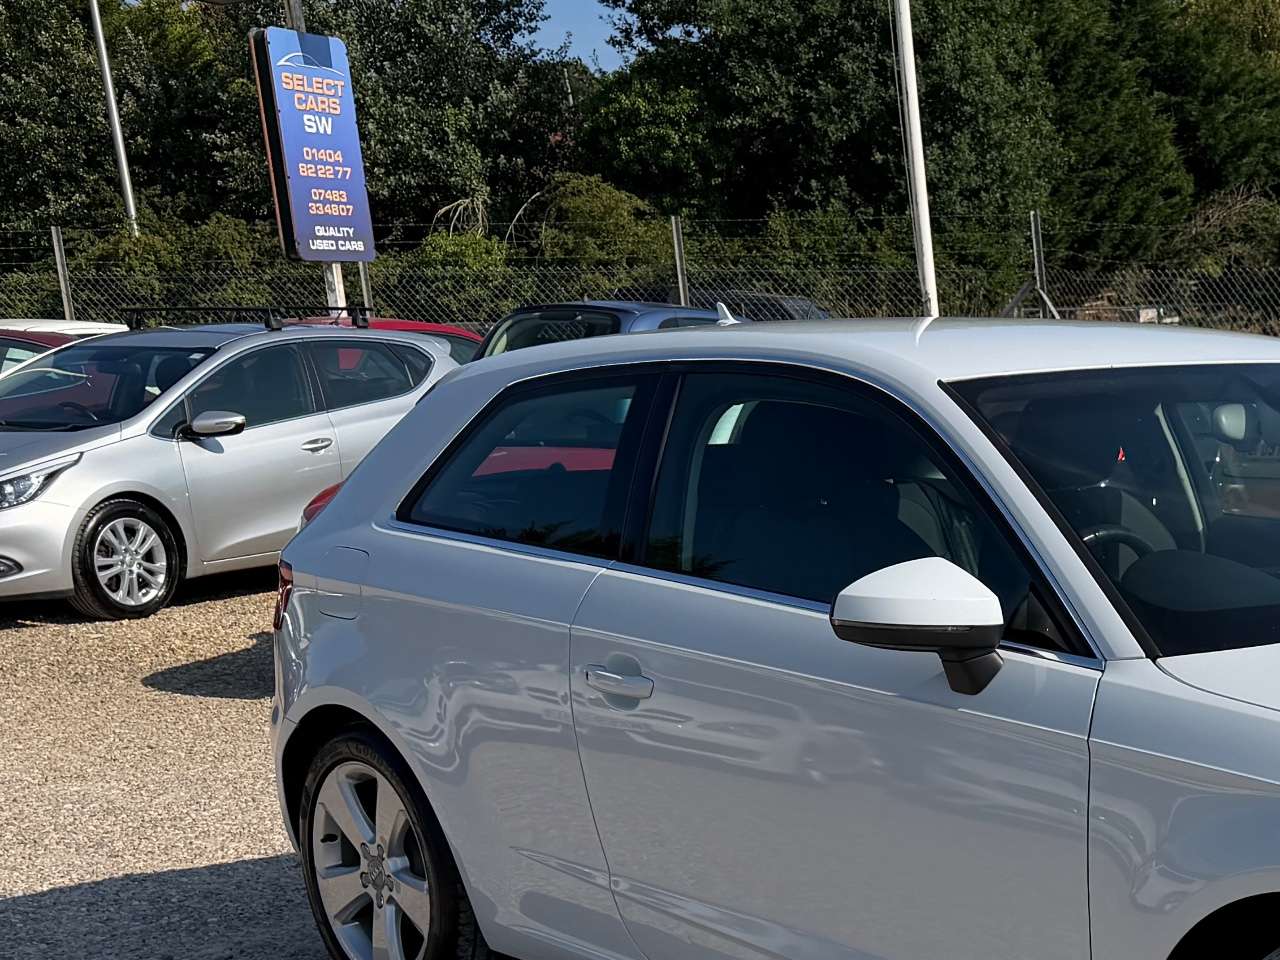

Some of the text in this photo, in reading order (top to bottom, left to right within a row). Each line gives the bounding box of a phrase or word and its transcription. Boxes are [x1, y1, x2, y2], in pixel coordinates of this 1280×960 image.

[281, 71, 345, 97] SELECT
[294, 93, 341, 115] CARS
[303, 114, 332, 135] SW
[303, 147, 342, 163] 01404
[311, 188, 348, 202] 07483
[308, 202, 353, 216] 334807
[314, 225, 354, 238] QUALITY
[309, 239, 365, 251] USED CARS
